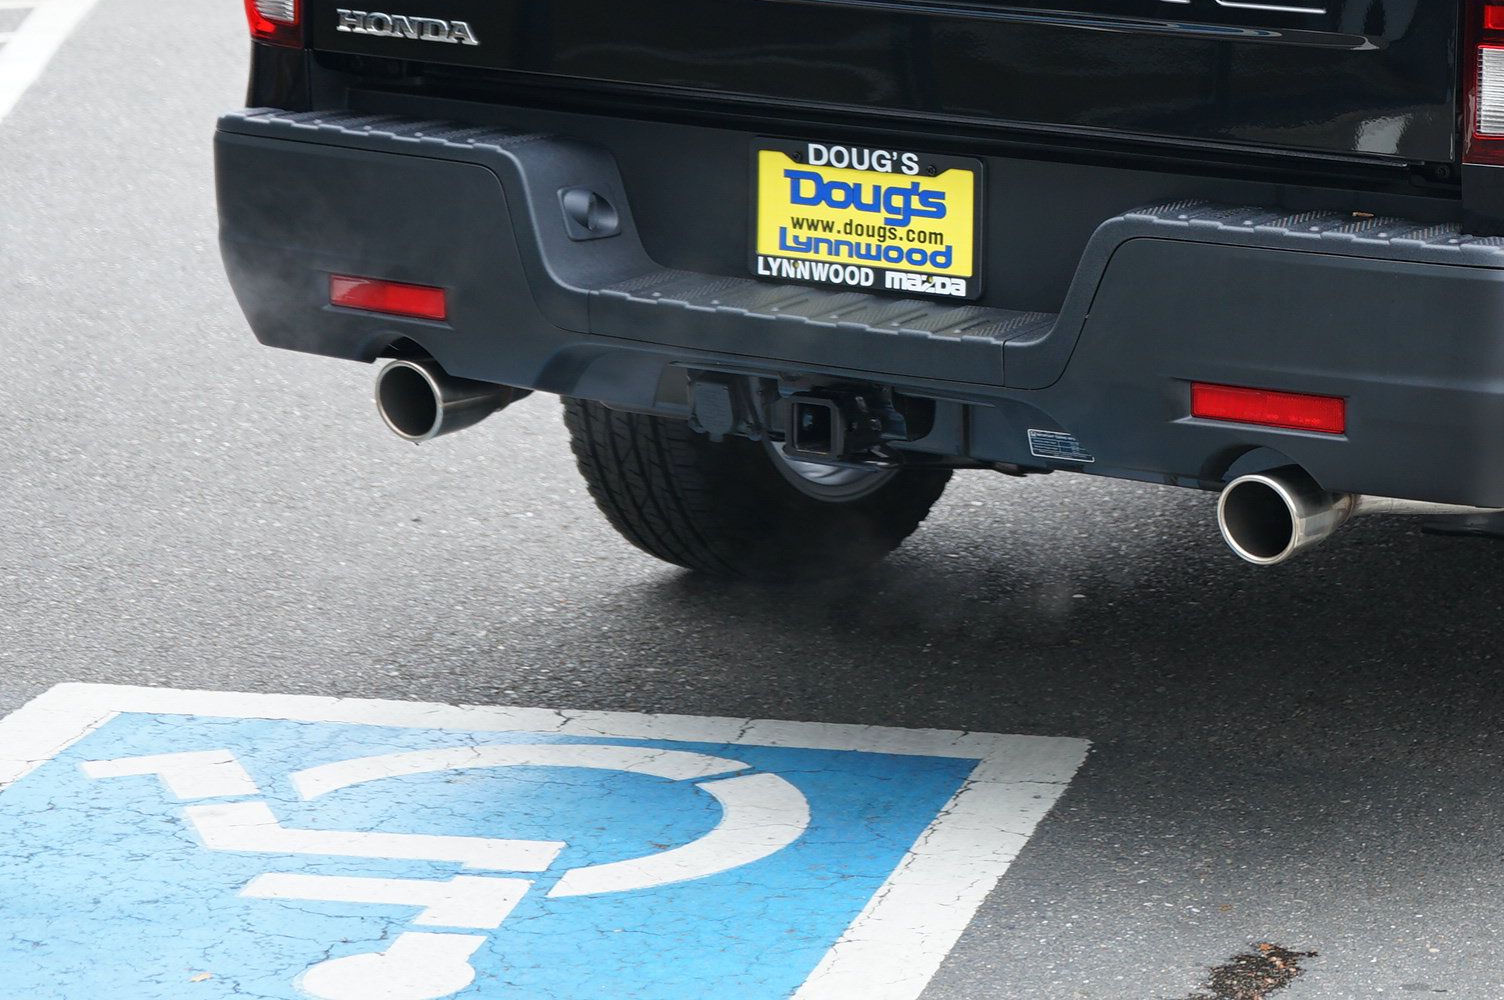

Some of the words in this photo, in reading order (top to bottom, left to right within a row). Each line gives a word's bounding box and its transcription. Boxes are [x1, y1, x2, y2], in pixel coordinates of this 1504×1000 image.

[336, 8, 479, 46] HONDA
[808, 144, 919, 175] DOUG'S
[784, 169, 947, 227] Doug's
[791, 216, 944, 245] www.dougs.com
[779, 227, 953, 269] Lynnwood
[757, 256, 874, 286] LYNNWOOD
